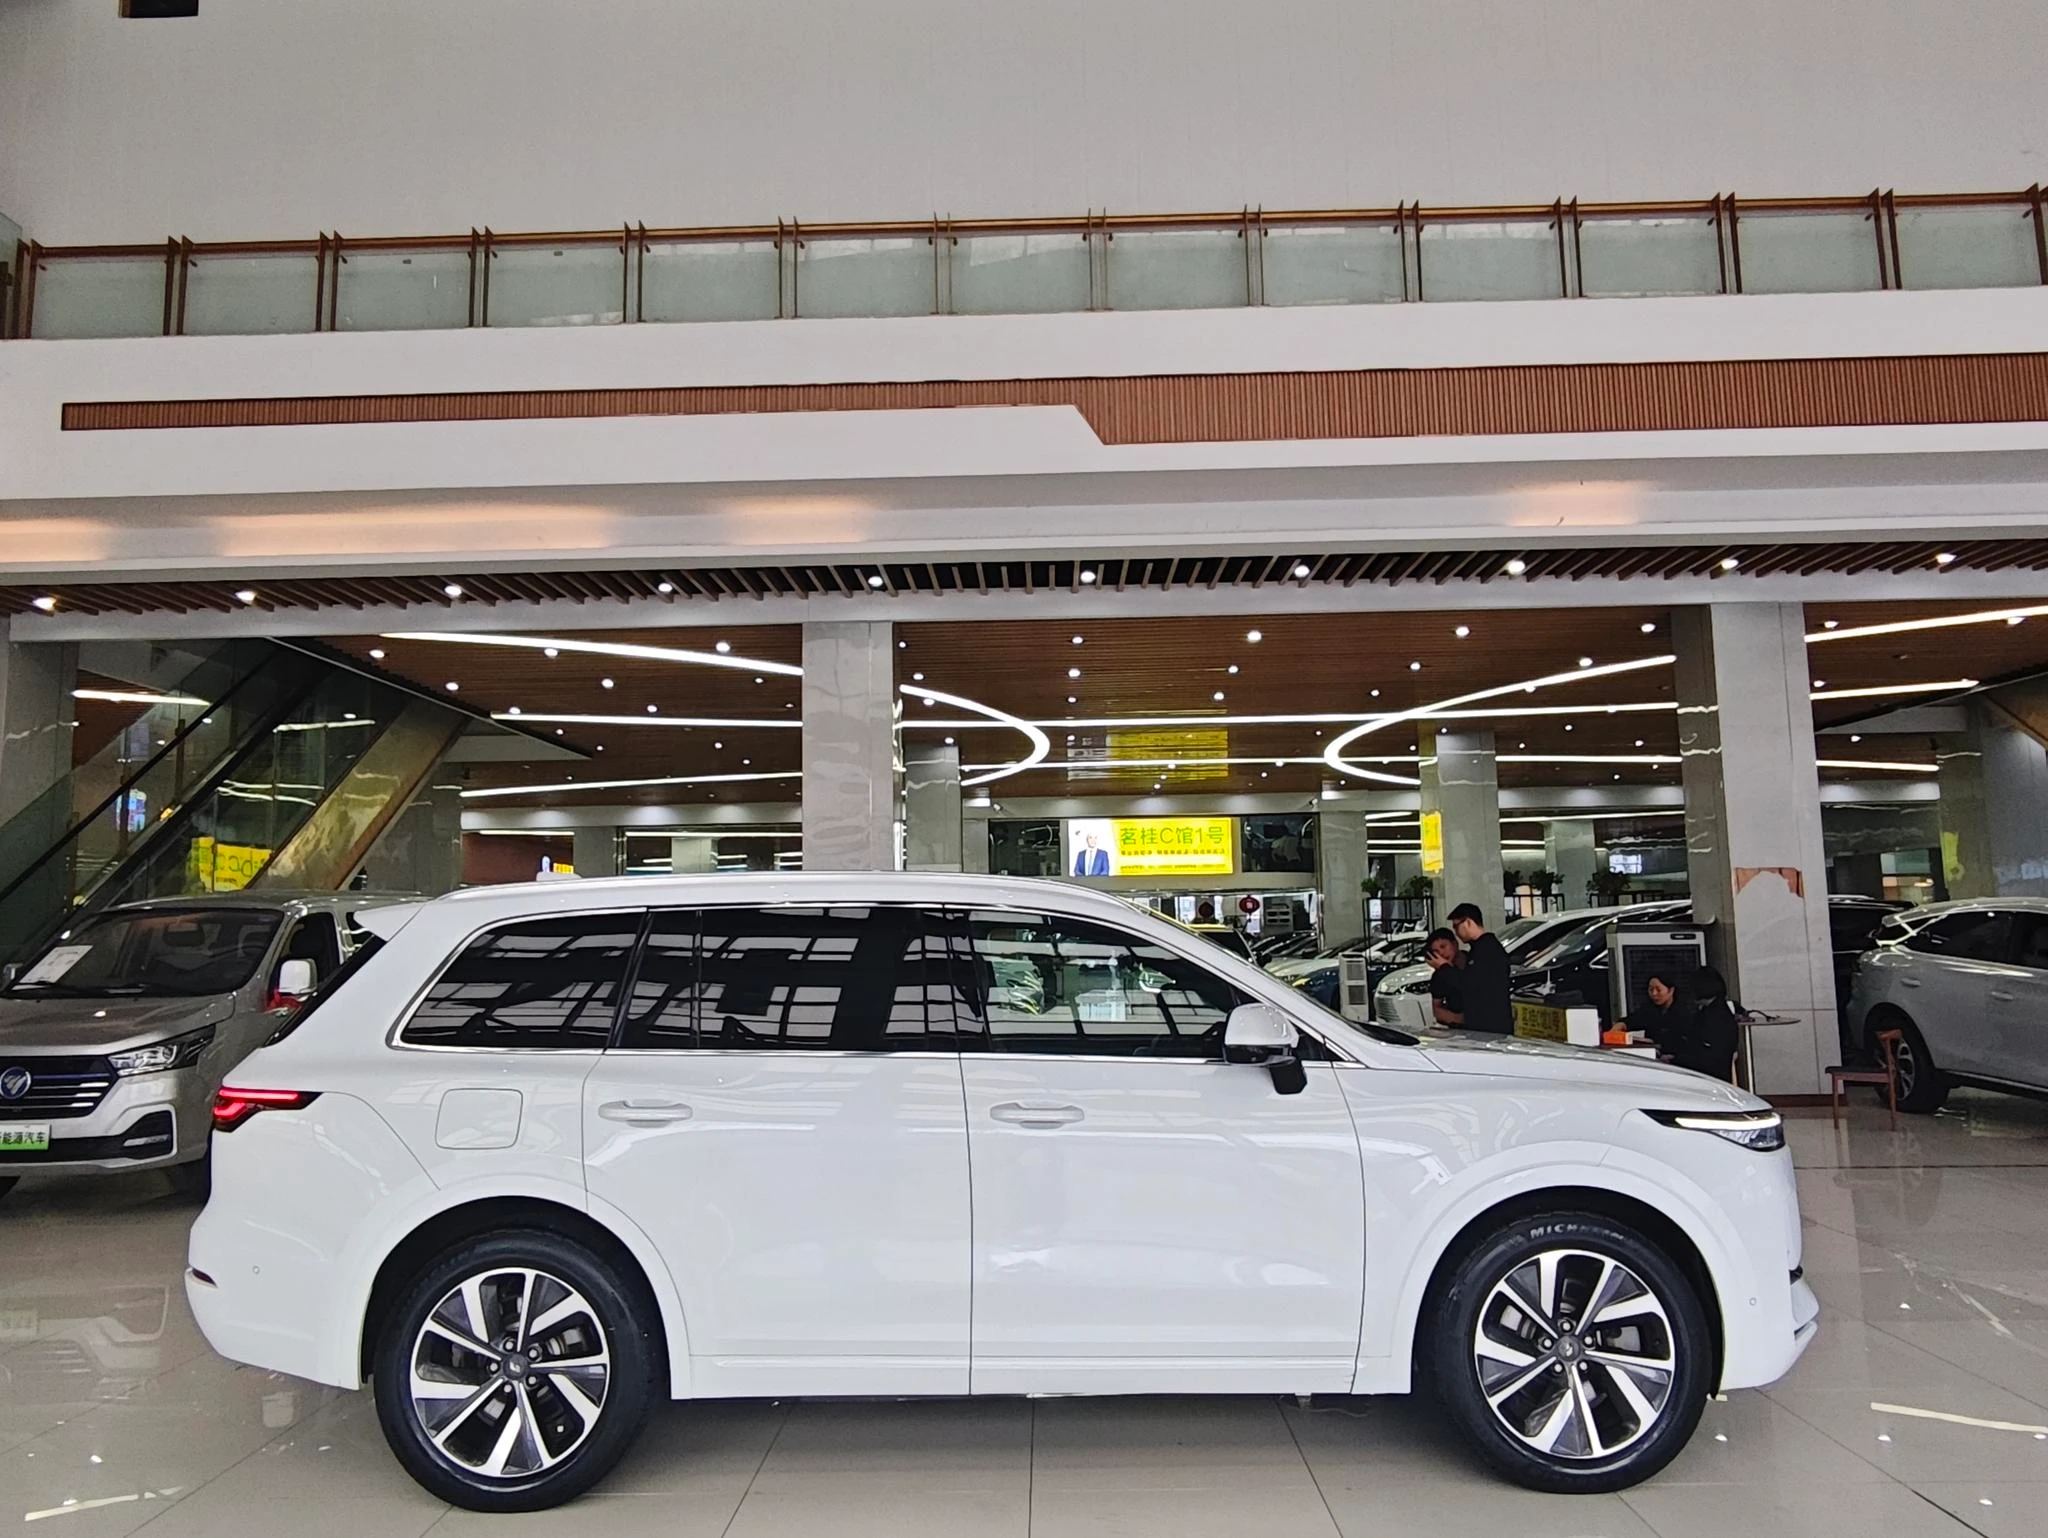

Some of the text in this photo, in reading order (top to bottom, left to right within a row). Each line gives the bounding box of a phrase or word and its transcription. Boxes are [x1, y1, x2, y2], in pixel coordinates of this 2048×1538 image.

[1120, 826, 1224, 845] 茗桂C馆1号
[0, 1131, 46, 1145] 能源汽车
